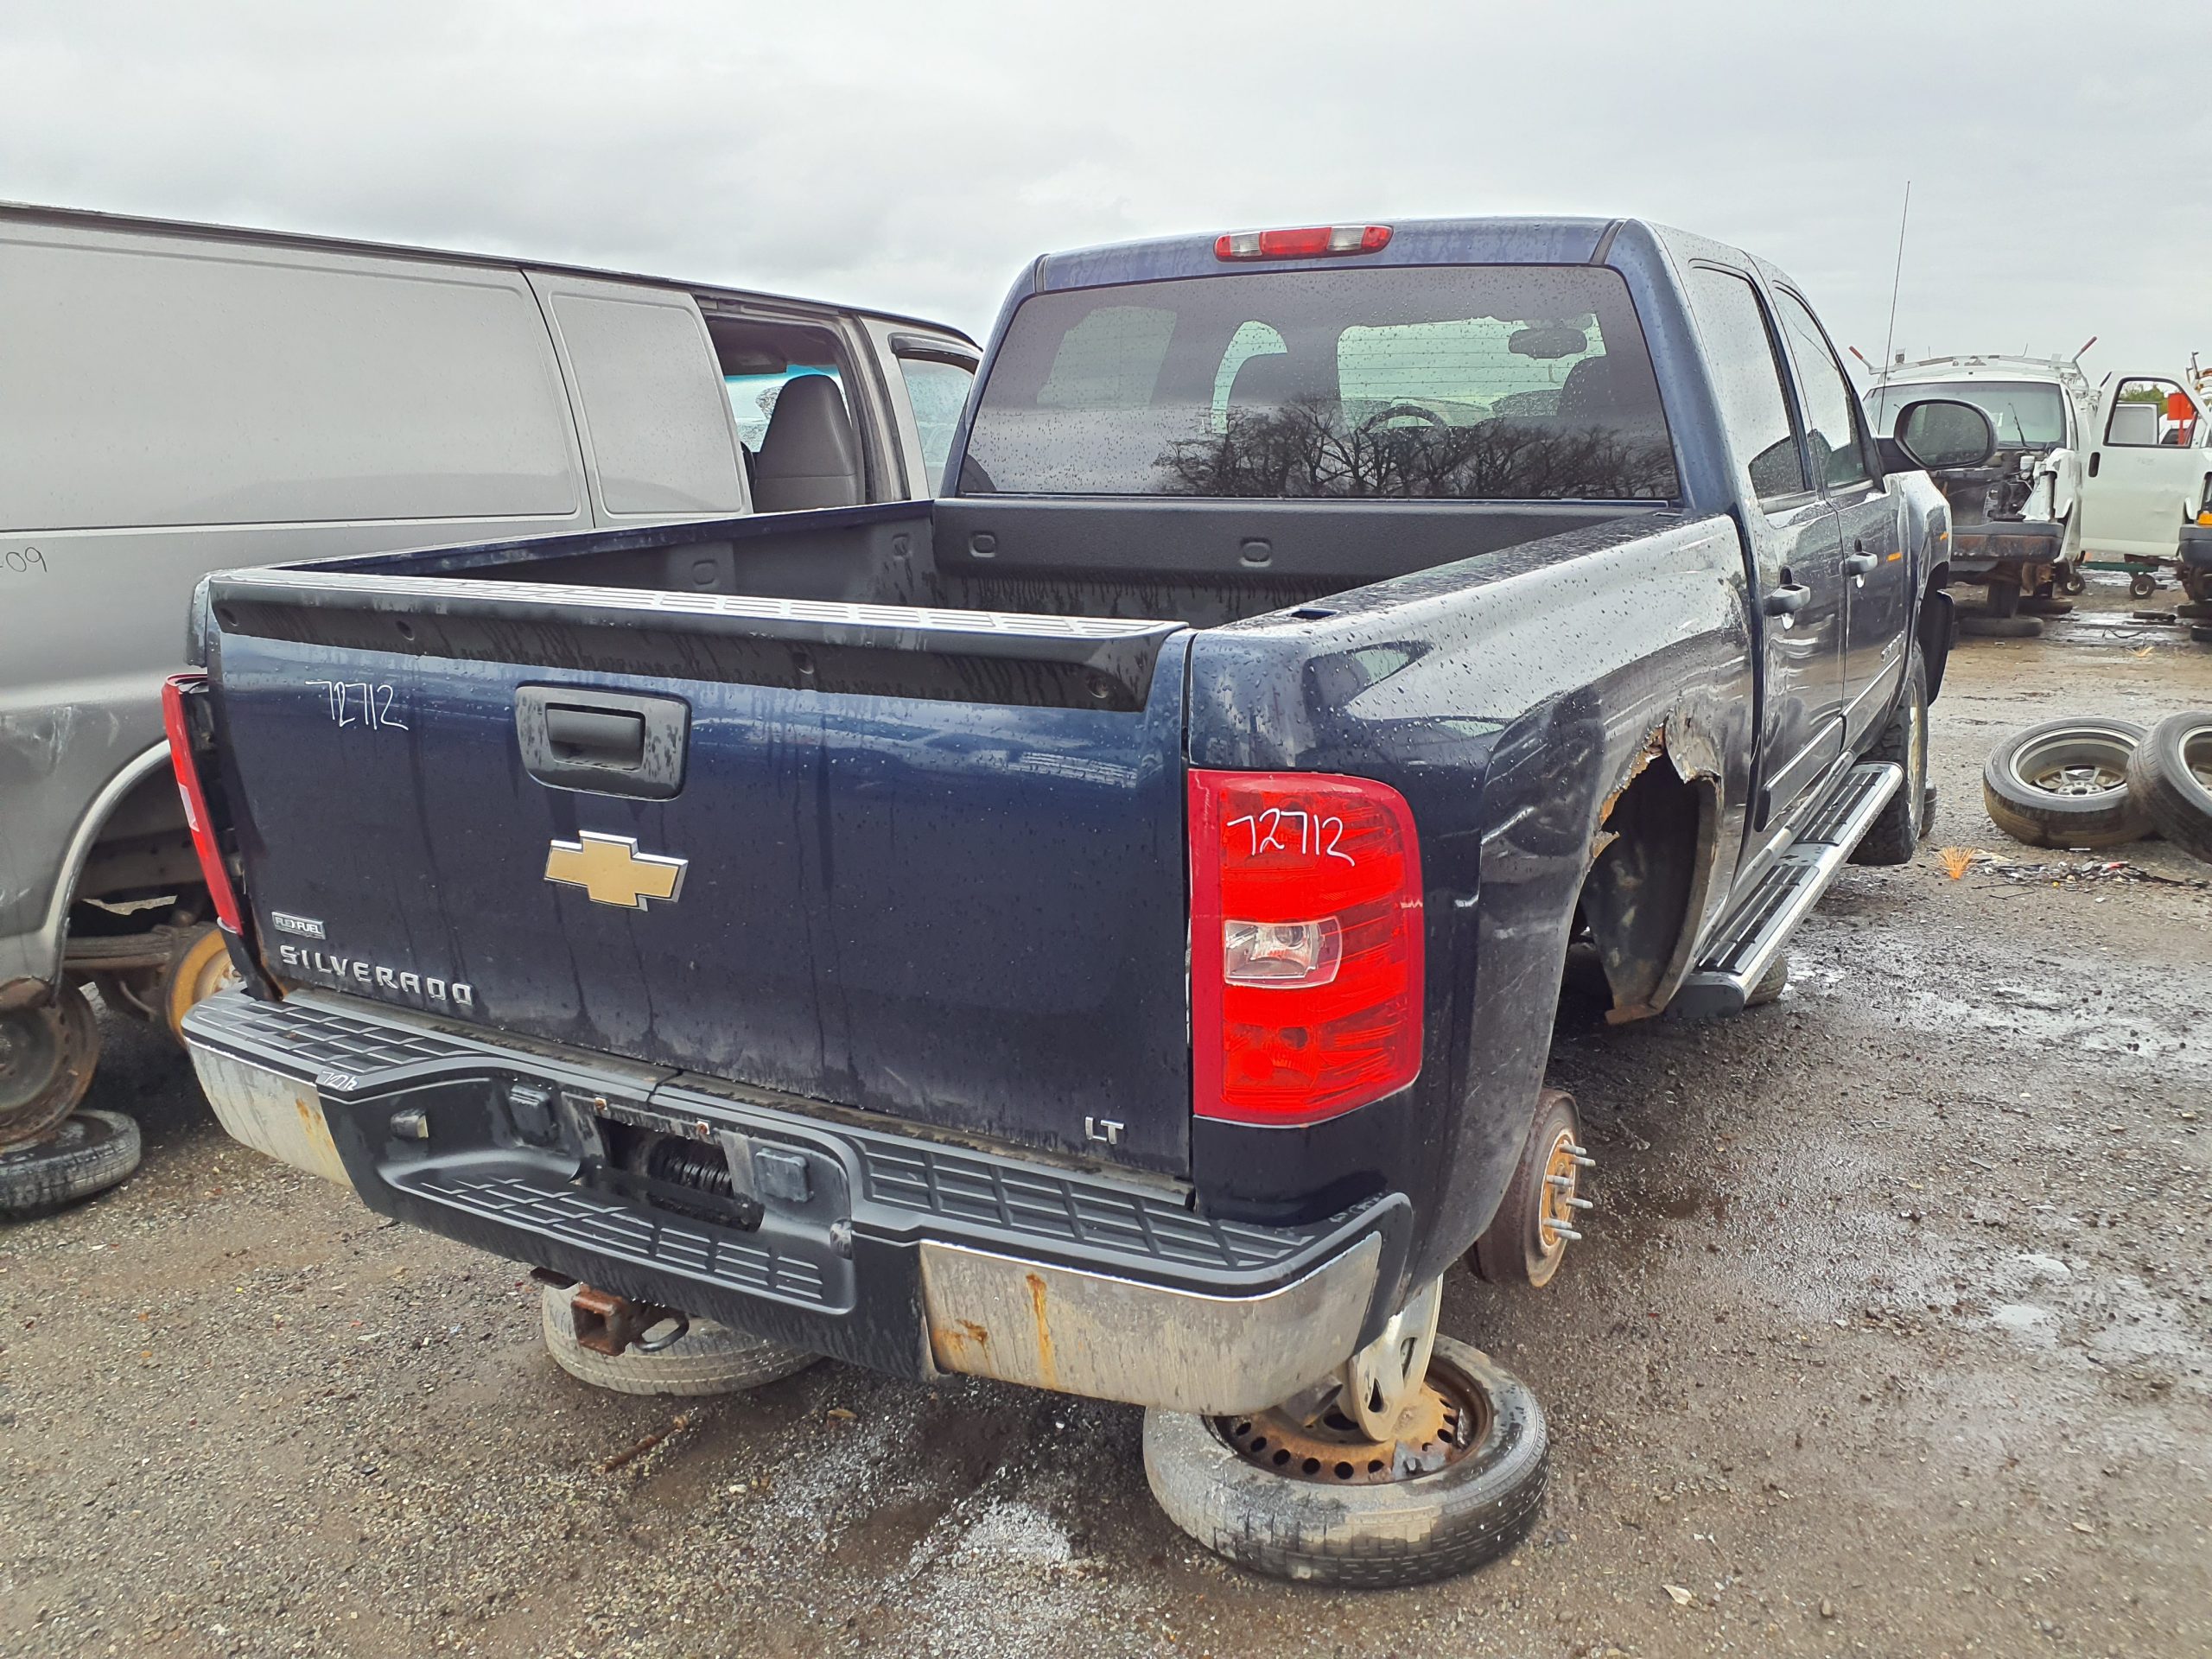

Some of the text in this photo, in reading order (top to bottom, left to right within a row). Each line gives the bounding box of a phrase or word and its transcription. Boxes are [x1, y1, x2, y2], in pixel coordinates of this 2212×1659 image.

[0, 546, 48, 573] 09
[305, 680, 409, 731] 72712
[1226, 807, 1356, 867] 72712
[280, 944, 473, 1006] SILVERADO
[1084, 1116, 1124, 1145] LT
